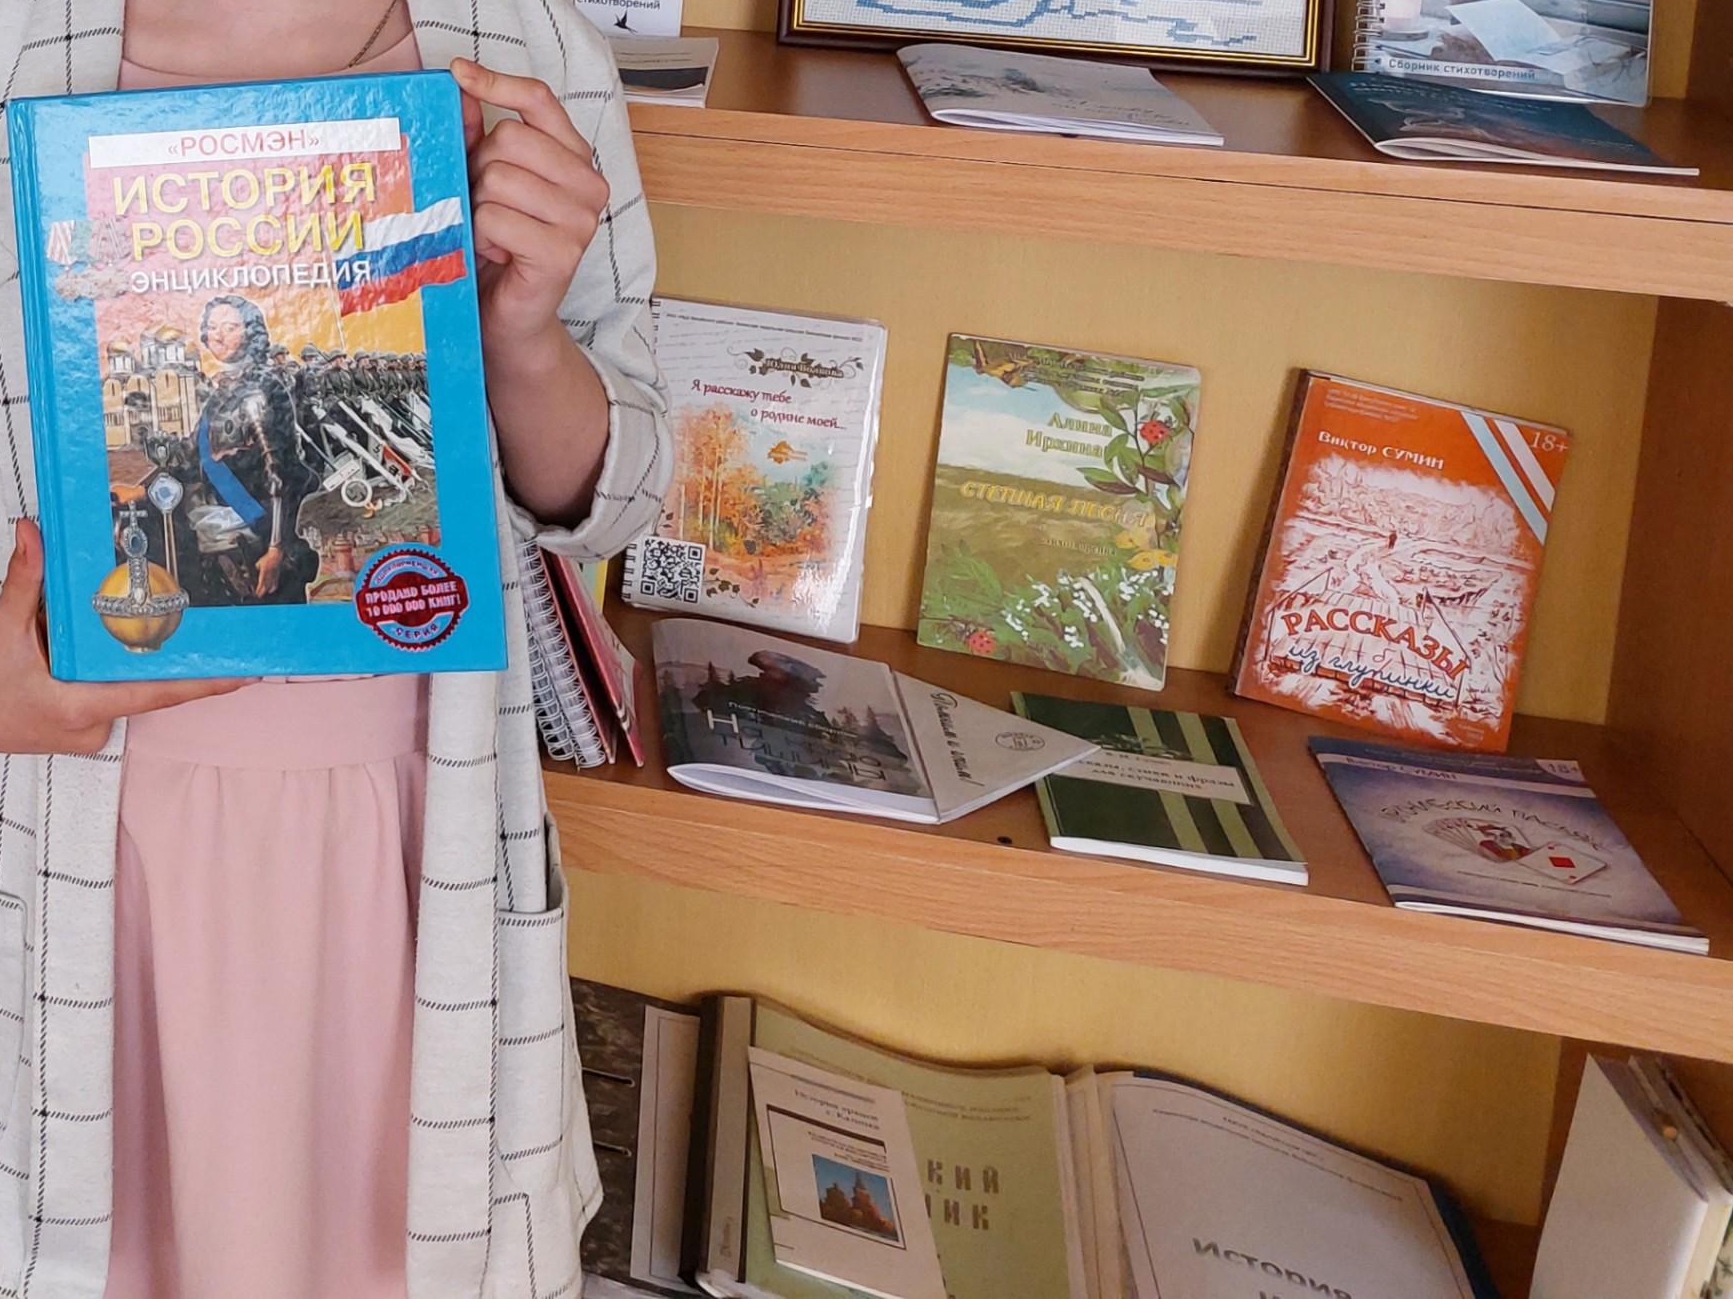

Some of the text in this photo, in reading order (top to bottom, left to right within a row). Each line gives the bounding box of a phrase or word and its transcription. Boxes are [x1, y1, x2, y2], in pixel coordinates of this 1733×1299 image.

[1388, 57, 1536, 80] Сборник стихотворений
[167, 128, 321, 159] «РОСМЭН»
[112, 162, 377, 217] ИСТОРИЯ
[129, 215, 366, 262] РОССИИ
[129, 258, 373, 295] ЭНЦИКЛОПЕДИЯ
[691, 379, 792, 404] Я расскажу тебе
[750, 409, 758, 417] о
[761, 409, 804, 425] родине
[1047, 412, 1113, 437] Алина
[1317, 429, 1377, 456] Виктор
[1530, 430, 1568, 452] 18+
[959, 481, 1065, 512] СТЕПНАЯ
[365, 581, 457, 604] ПРОДАНО БОЛЕЕ
[366, 605, 380, 617] 10
[382, 602, 403, 615] 000
[405, 599, 425, 612] 000
[1280, 607, 1469, 680] РАССКАЗЫ
